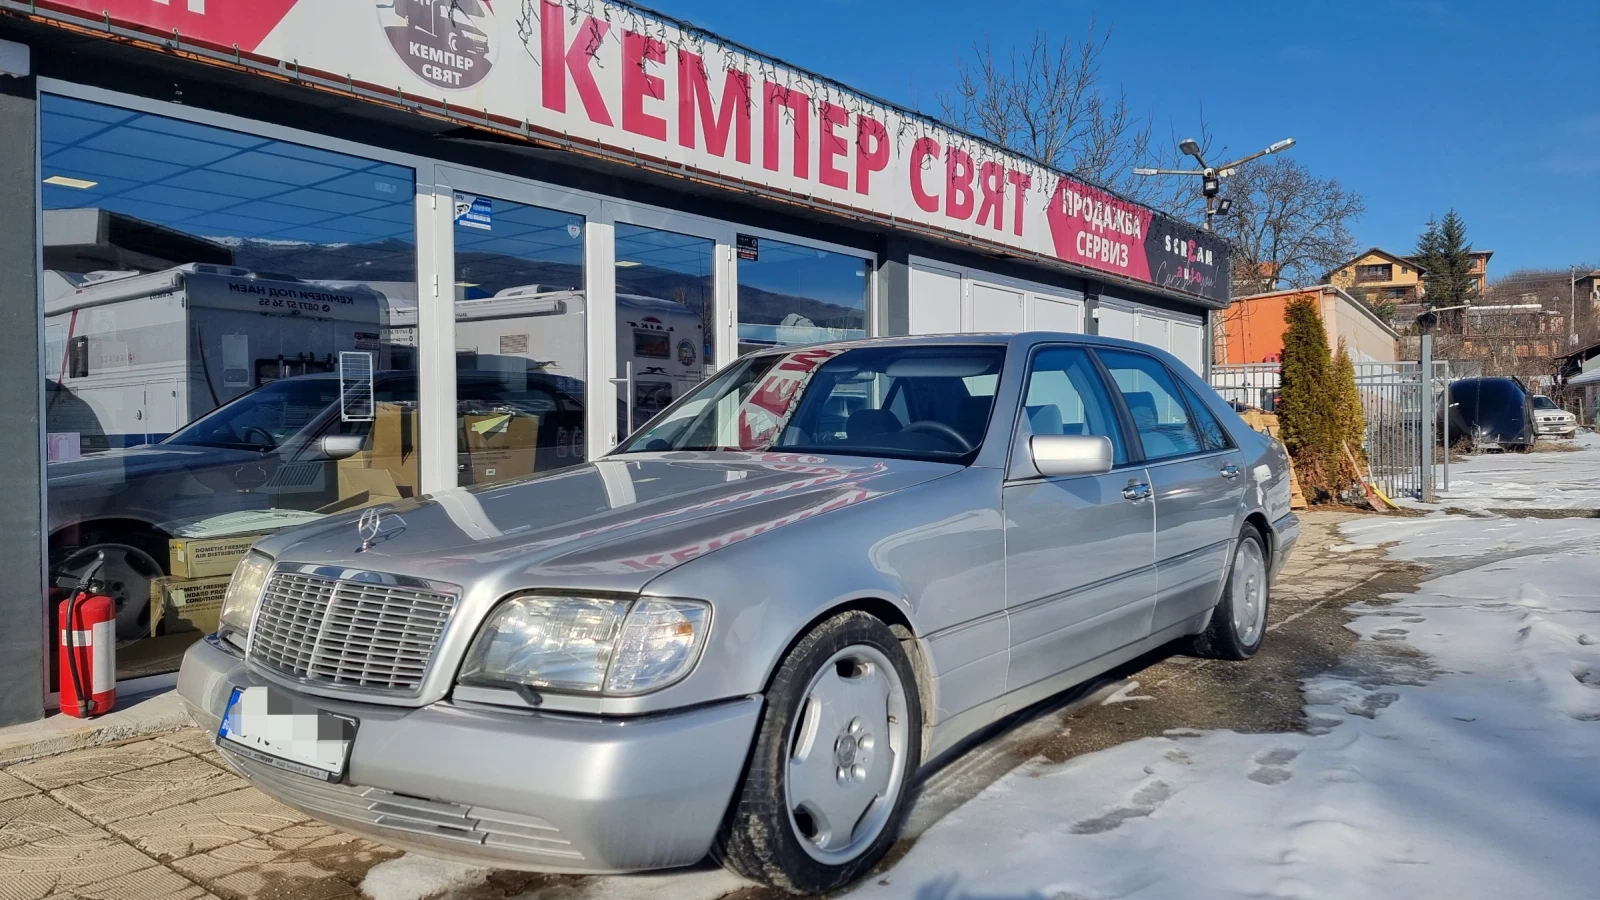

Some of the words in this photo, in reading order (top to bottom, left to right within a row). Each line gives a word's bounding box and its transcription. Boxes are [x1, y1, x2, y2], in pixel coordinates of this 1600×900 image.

[409, 41, 474, 72] КЕМПЕР
[421, 64, 463, 86] СВЯТ
[540, 0, 890, 196] КЕМПЕР
[909, 136, 1032, 237] СВЯТ
[1062, 188, 1141, 239] ПРОДАЖБА
[1076, 230, 1129, 268] СЕРВИЗ
[1177, 265, 1202, 283] auto
[175, 585, 203, 594] METIC
